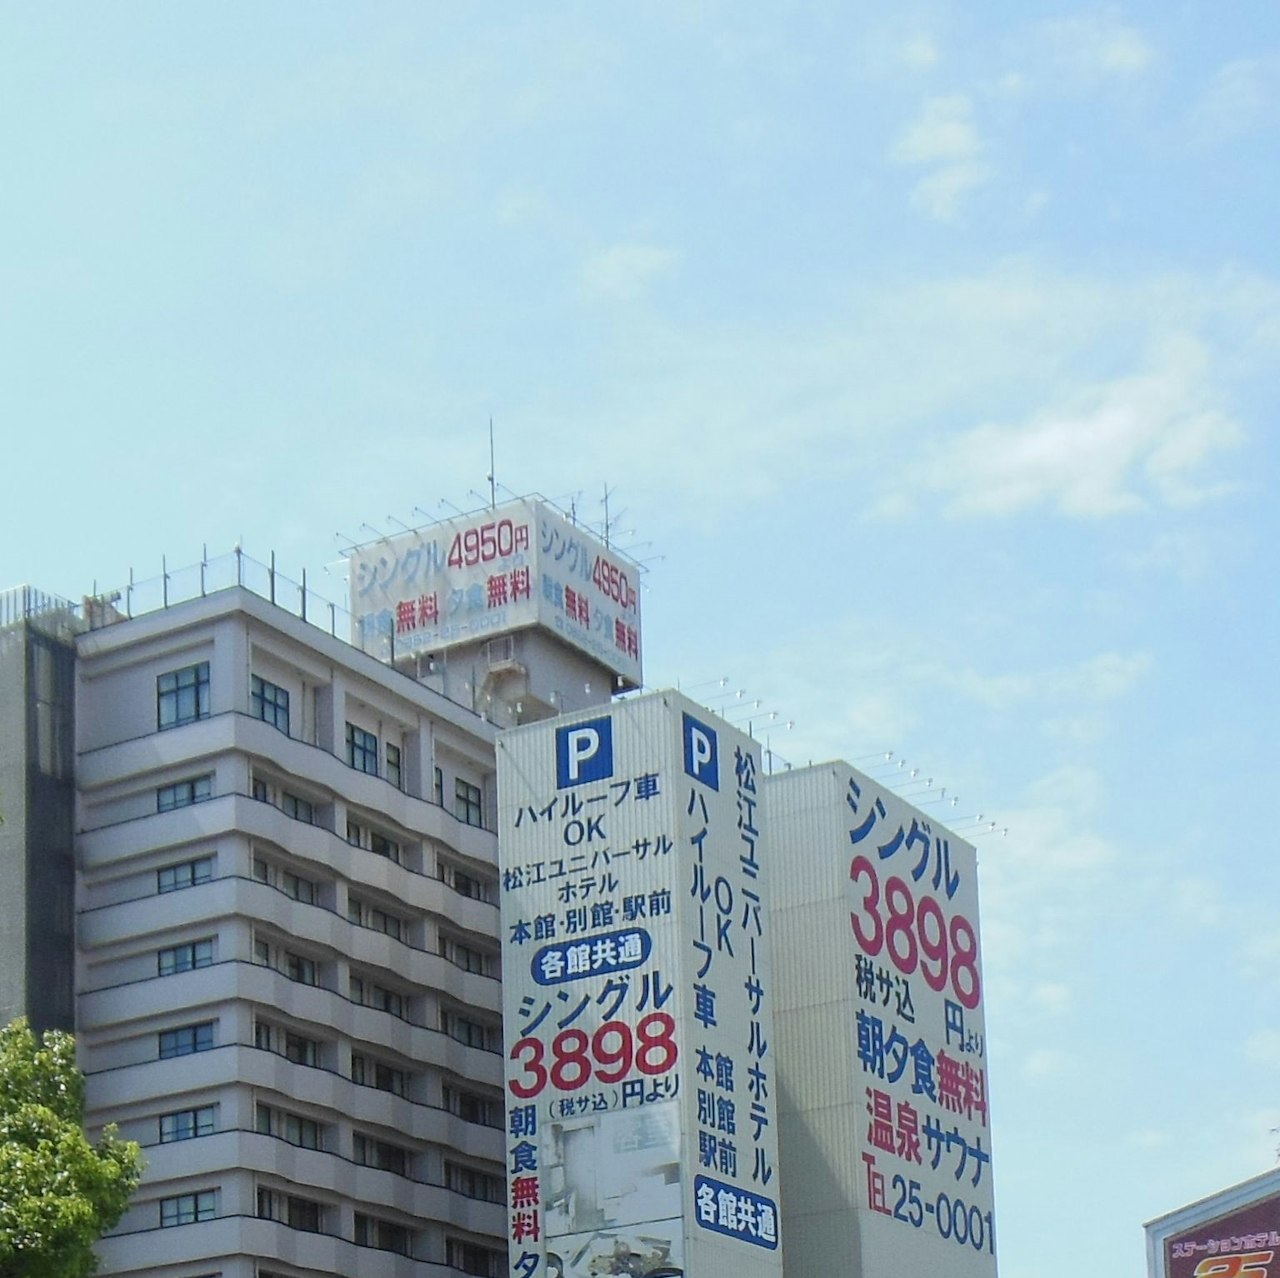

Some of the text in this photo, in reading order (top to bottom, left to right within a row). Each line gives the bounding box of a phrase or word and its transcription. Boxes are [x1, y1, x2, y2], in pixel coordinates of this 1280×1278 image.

[567, 727, 600, 780] P
[691, 726, 712, 776] P
[514, 772, 661, 829] ハイルーフ車
[563, 813, 606, 847] OK
[502, 834, 674, 892] 松江ユニバーサル
[846, 776, 961, 901] シングル
[558, 872, 620, 904] ホテル
[687, 787, 718, 1029] ハイルーフ車
[714, 875, 735, 959] OK
[540, 931, 643, 981] 各館共通
[733, 744, 773, 1187] 松江ユニバーサルホテル
[849, 854, 982, 1011] 3898
[518, 970, 675, 1038] シングル
[855, 952, 916, 1025] 税サ込
[508, 1012, 679, 1099] 3898
[943, 998, 984, 1059] 円より
[855, 1007, 988, 1128] 朝夕食無料
[865, 1085, 990, 1189] 温泉サウナ
[509, 1103, 541, 1245] 朝食無料
[696, 1183, 777, 1244] 各館共通
